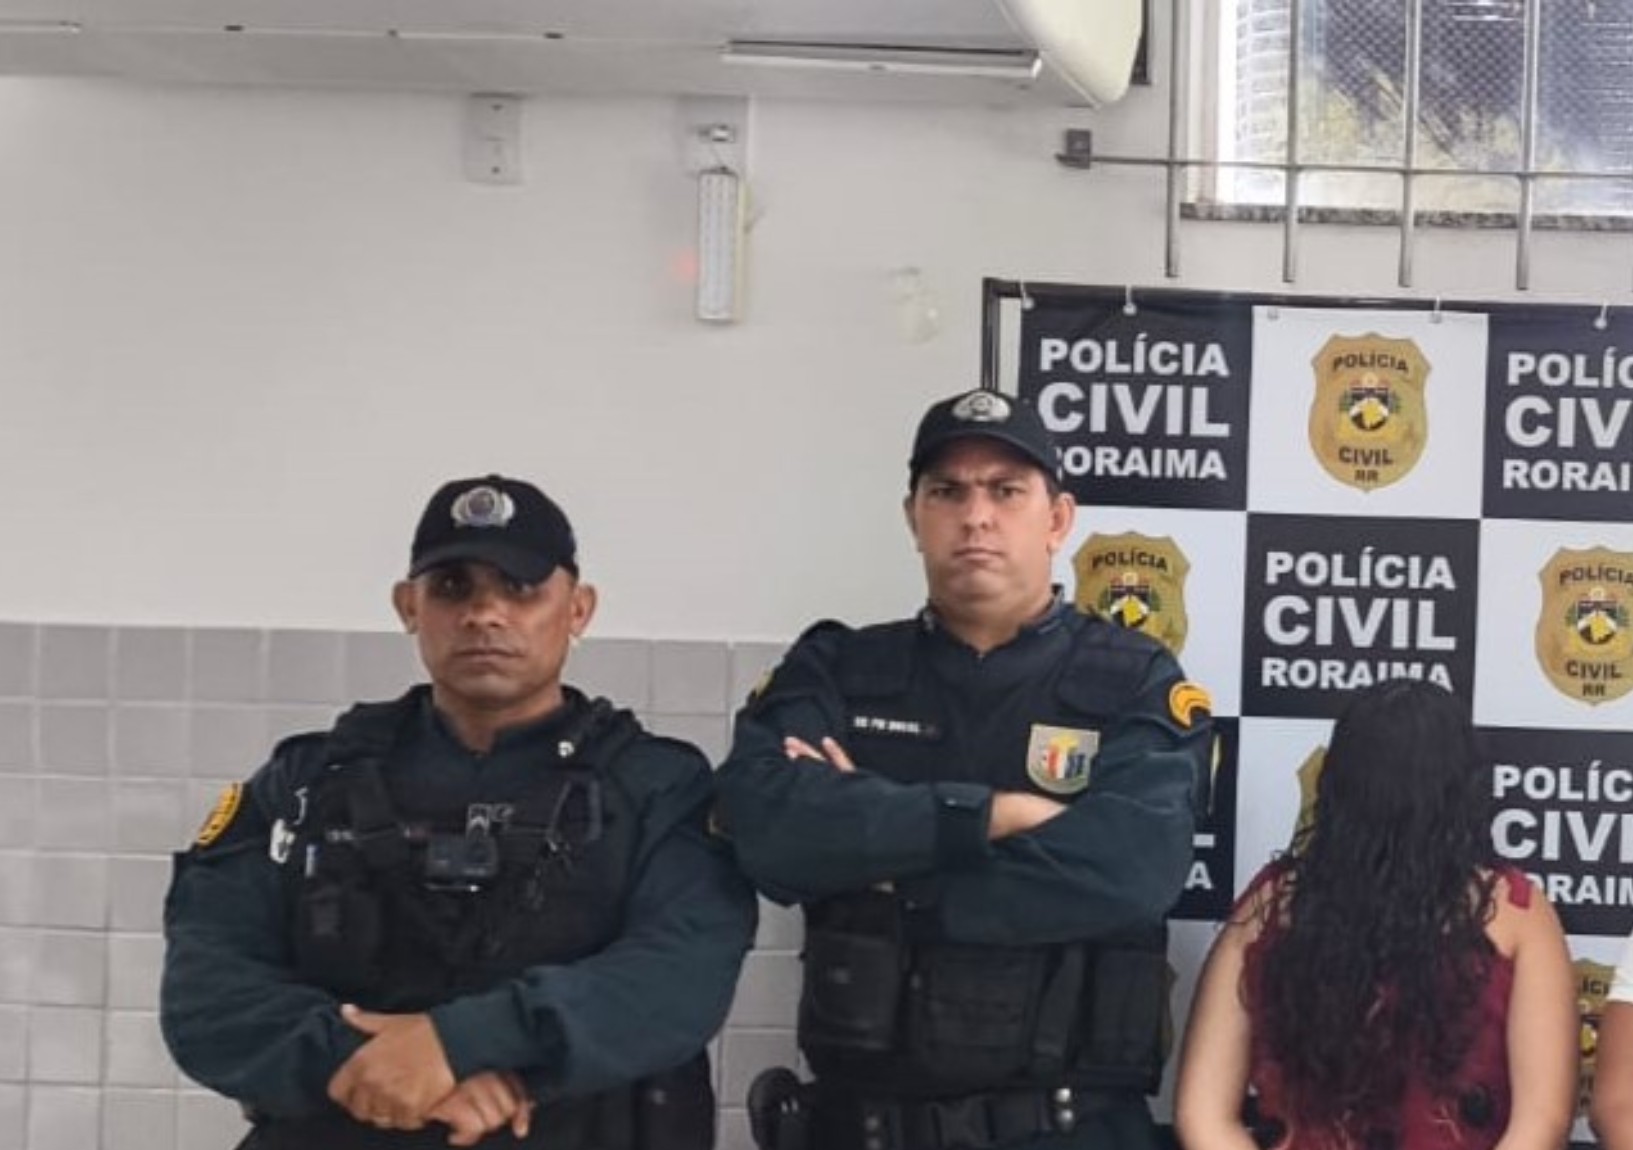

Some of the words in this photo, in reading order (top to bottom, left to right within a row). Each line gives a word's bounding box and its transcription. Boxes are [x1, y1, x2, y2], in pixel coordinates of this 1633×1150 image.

[1040, 332, 1230, 377] POLÍCIA
[1333, 350, 1409, 372] POLÍCIA
[1037, 382, 1230, 438] CIVIL
[1056, 446, 1227, 480] ORAIMA
[1339, 446, 1393, 466] CIVIL
[1354, 469, 1379, 483] RR
[1092, 548, 1168, 572] POLÍCIA
[1266, 546, 1456, 590] POLÍCIA
[1263, 596, 1456, 651] CIVIL
[1566, 660, 1623, 680] CIVIL
[1583, 683, 1606, 696] RR
